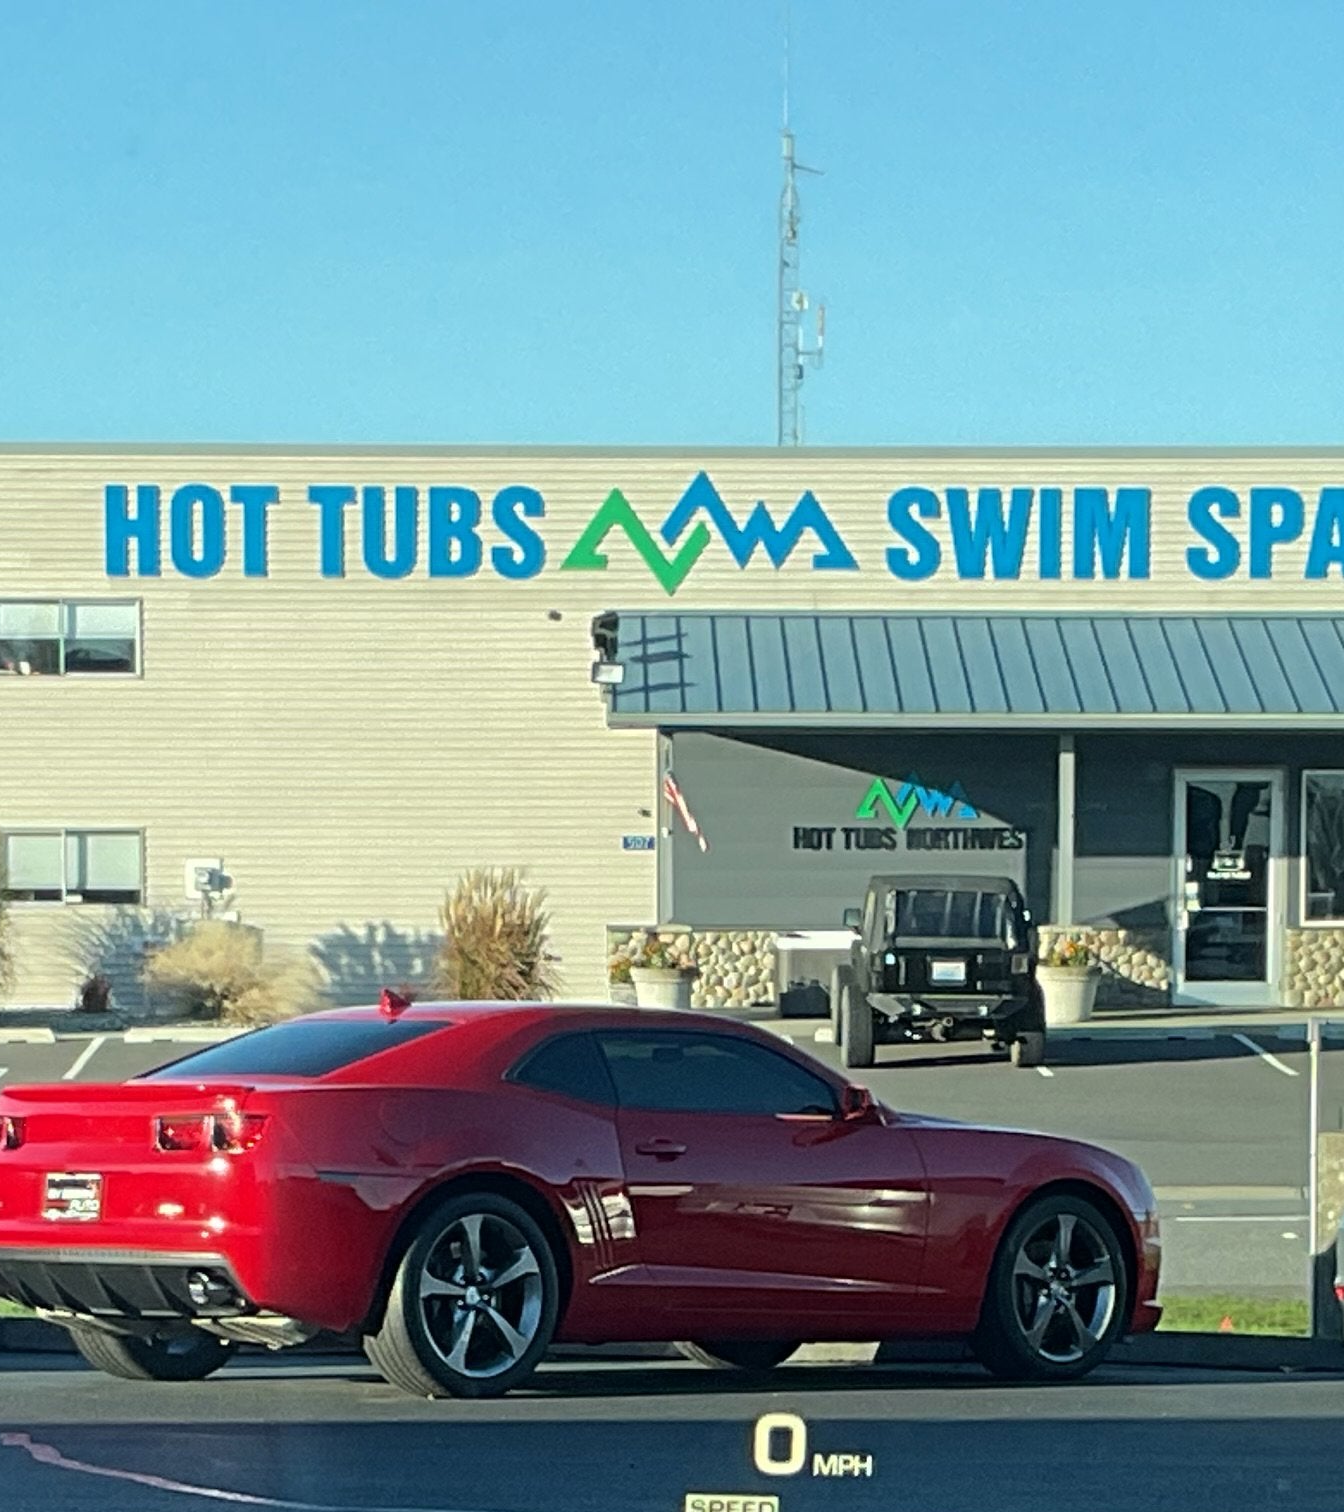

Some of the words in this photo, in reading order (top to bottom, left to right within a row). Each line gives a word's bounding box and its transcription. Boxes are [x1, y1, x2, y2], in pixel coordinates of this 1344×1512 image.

[105, 483, 279, 578] HOT
[309, 484, 547, 579] TUBS
[886, 486, 1153, 581] SWIM
[793, 826, 837, 850] HOT
[841, 826, 898, 850] TUBS
[907, 826, 1024, 850] NORTHWES
[754, 1412, 808, 1476] 0
[813, 1454, 873, 1477] MPH
